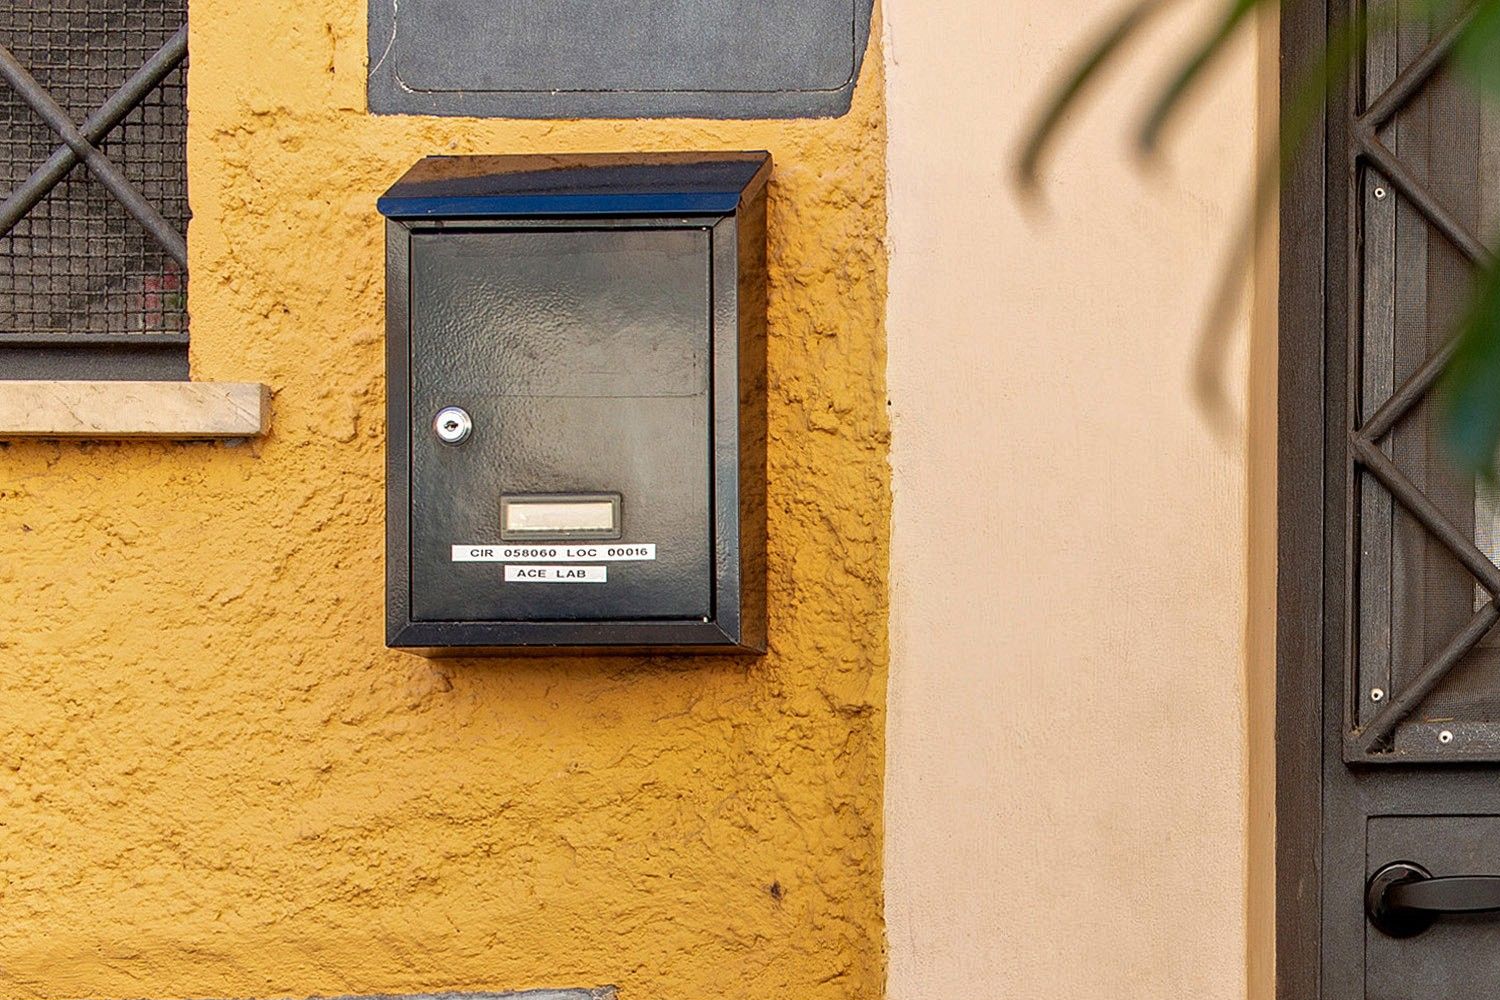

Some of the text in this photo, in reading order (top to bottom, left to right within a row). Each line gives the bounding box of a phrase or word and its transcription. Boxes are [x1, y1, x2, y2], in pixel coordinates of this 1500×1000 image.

[470, 548, 648, 558] CIR 058060 LOC 00016
[517, 569, 586, 578] ACE LAB
